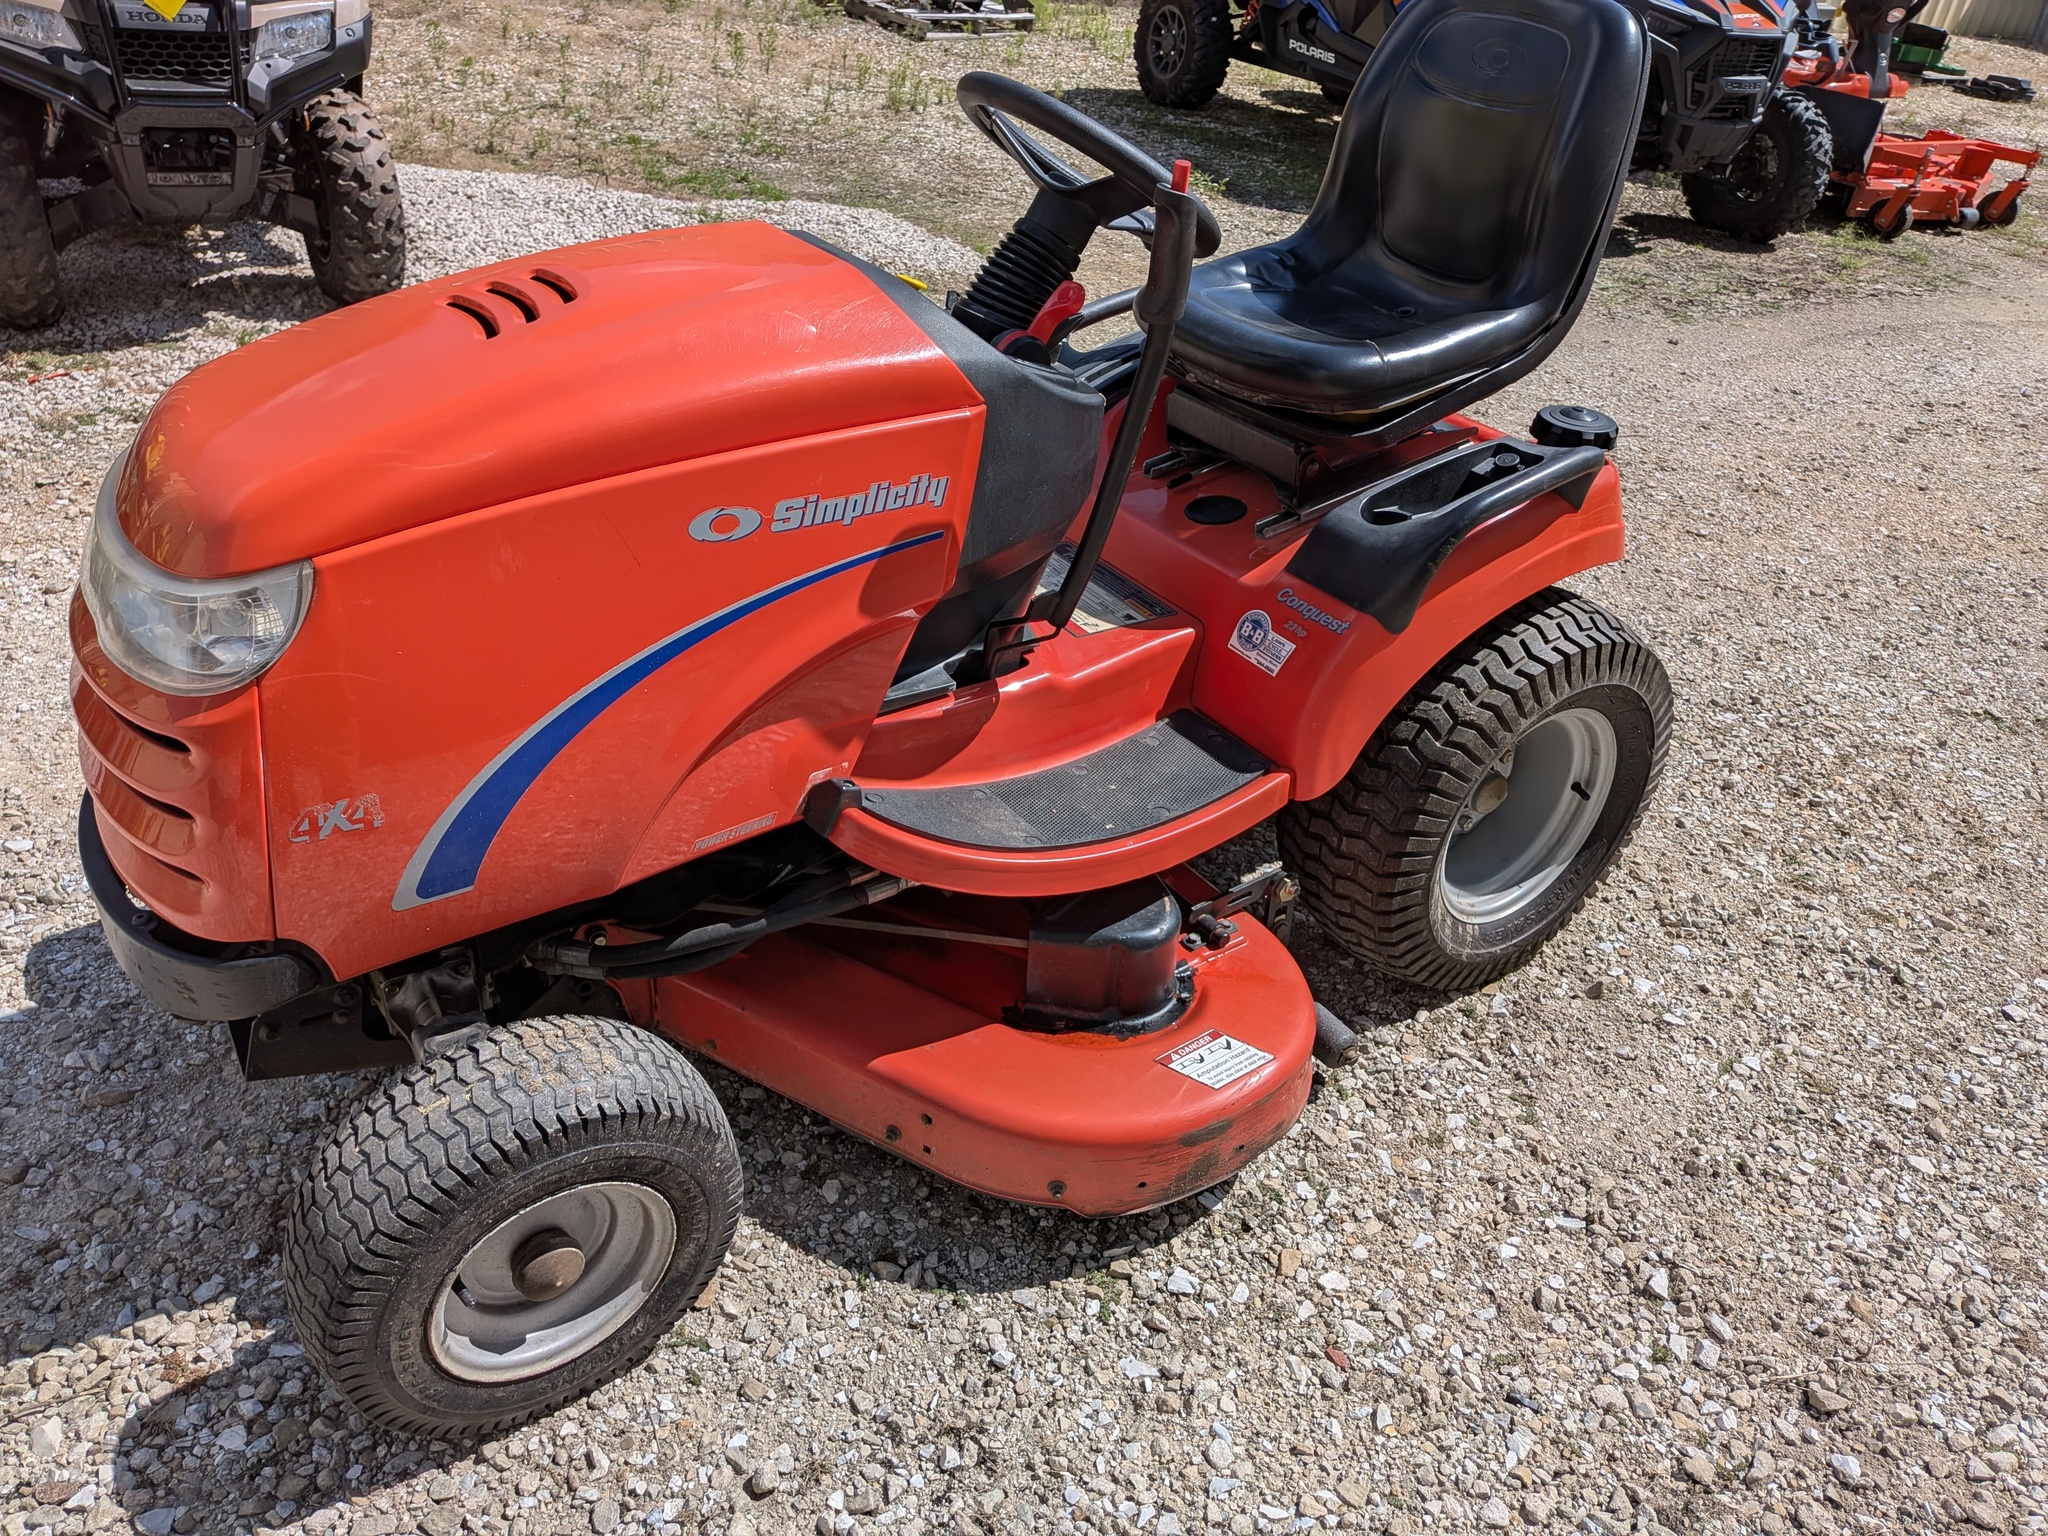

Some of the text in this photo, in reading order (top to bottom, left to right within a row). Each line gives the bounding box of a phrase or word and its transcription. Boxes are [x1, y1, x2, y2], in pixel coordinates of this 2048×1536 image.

[1288, 38, 1336, 64] POLARIS
[770, 473, 950, 533] Simplicity
[1277, 588, 1351, 635] Conquest
[1270, 636, 1286, 647] LAWN
[1284, 620, 1307, 638] 23 hp
[1262, 646, 1282, 660] FITNESS
[1267, 642, 1282, 653] CYCLE
[693, 814, 775, 852] POWER STEERING
[1179, 1035, 1213, 1057] DANGER
[1196, 1047, 1251, 1079] Amputation Hazard
[1212, 1070, 1223, 1078] avoid
[1223, 1064, 1235, 1073] injury
[1243, 1051, 1258, 1062] rotating
